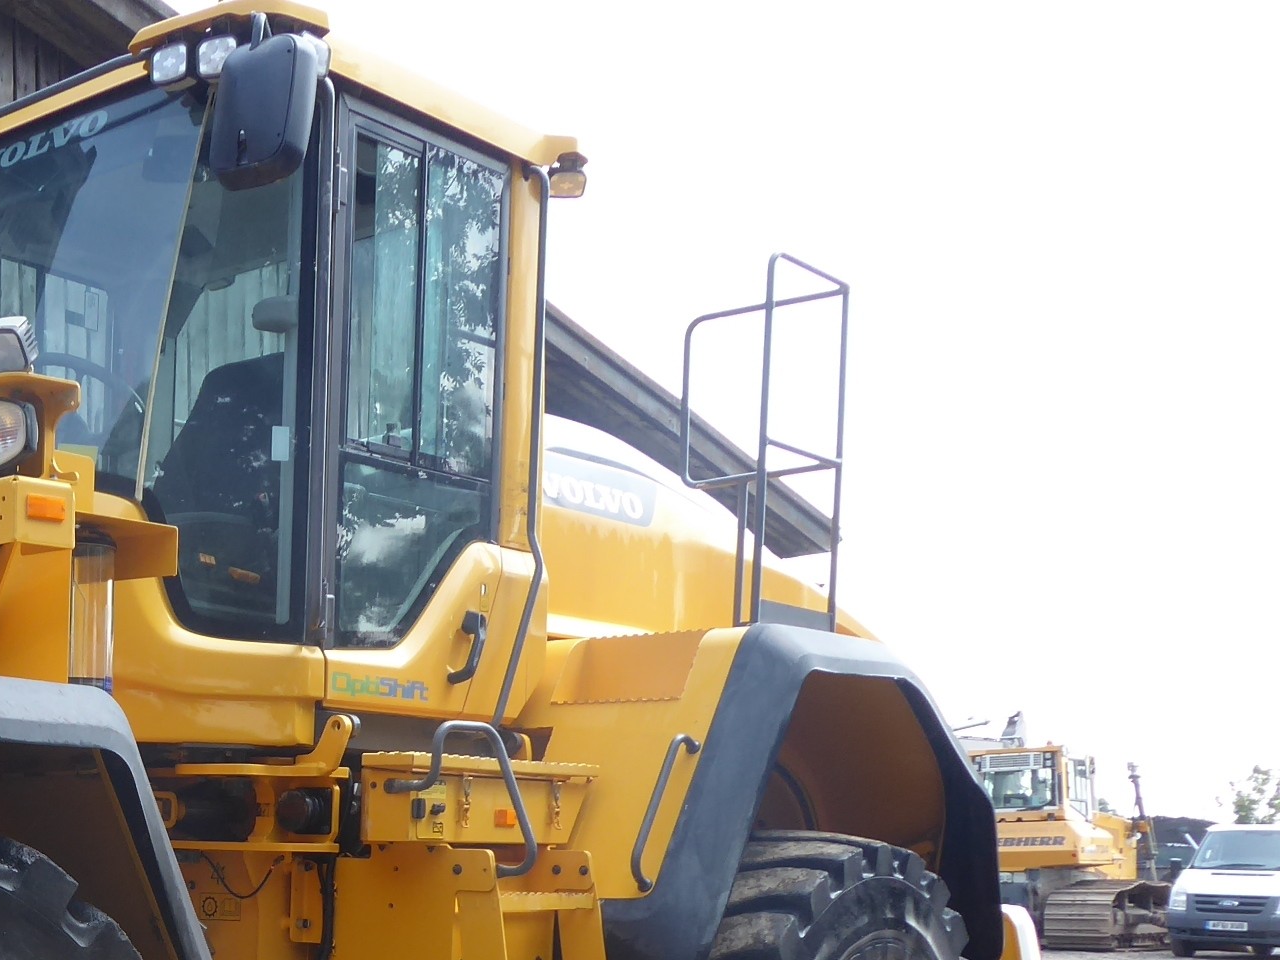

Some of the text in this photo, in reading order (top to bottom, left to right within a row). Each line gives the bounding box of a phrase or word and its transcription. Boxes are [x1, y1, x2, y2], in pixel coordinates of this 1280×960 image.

[543, 471, 644, 519] VOLVO
[332, 672, 428, 701] OptiShift
[998, 836, 1066, 847] EBHERR
